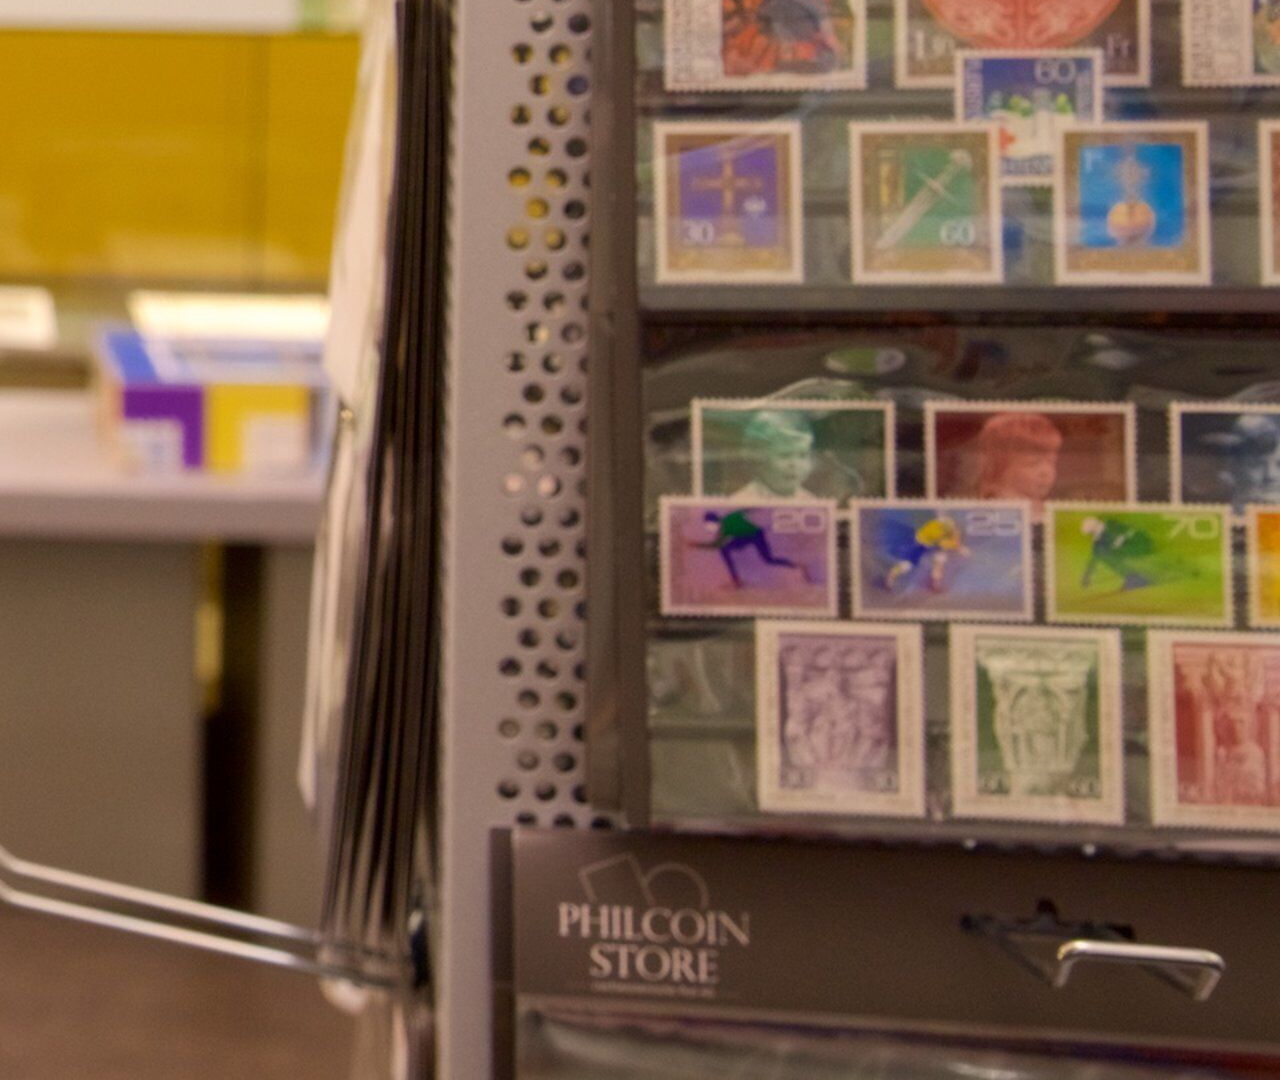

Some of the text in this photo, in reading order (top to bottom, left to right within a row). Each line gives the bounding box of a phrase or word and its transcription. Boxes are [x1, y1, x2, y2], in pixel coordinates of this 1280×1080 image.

[1164, 514, 1221, 539] 70
[558, 901, 751, 945] PHILCOIN
[591, 942, 720, 984] STORE
